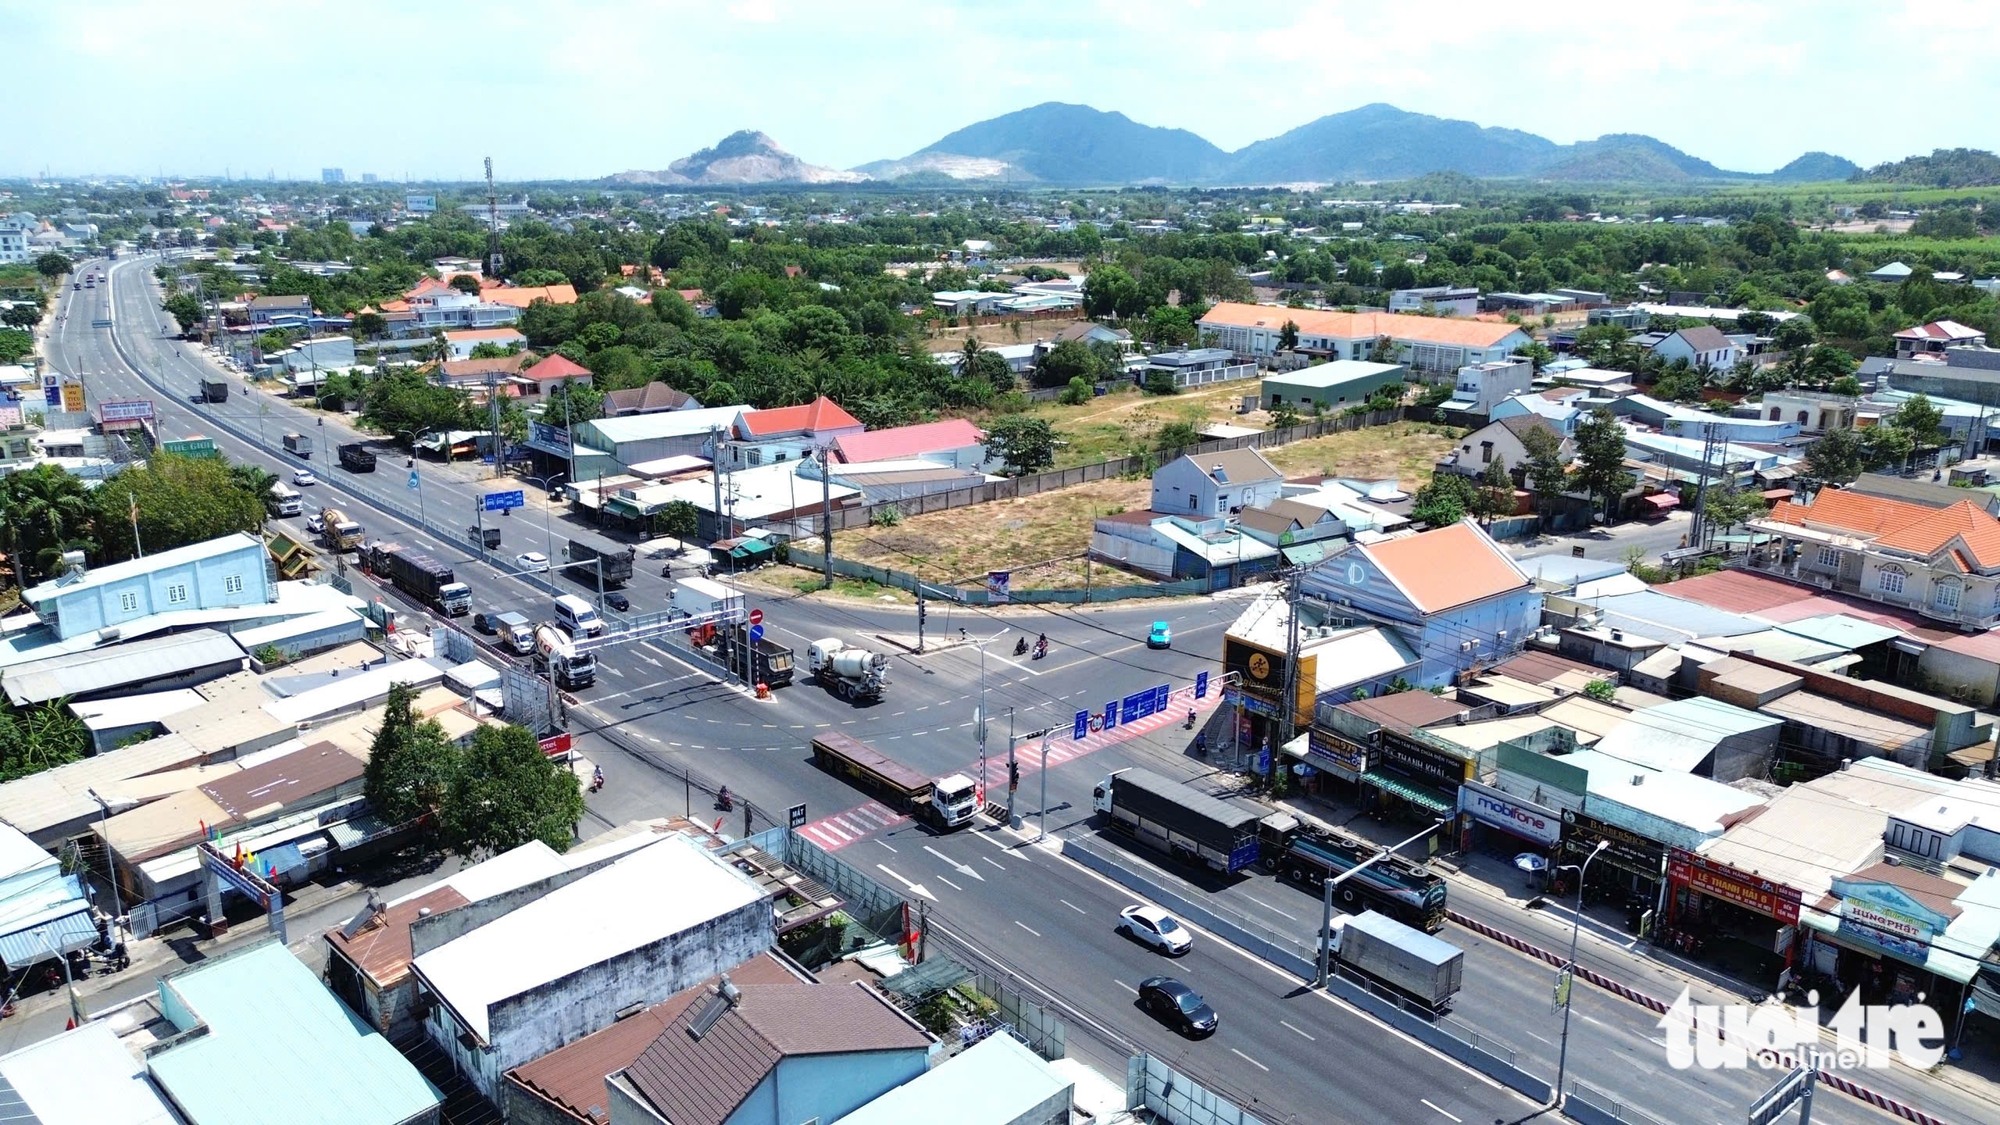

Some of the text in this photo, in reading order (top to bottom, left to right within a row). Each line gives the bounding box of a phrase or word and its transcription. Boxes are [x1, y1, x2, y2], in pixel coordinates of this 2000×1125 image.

[1397, 752, 1423, 769] THANH
[1477, 797, 1545, 830] mobifone
[1697, 872, 1709, 881] LÊ
[1711, 877, 1740, 894] THANH
[1742, 888, 1758, 900] HẢI
[1852, 907, 1886, 924] HƯNG
